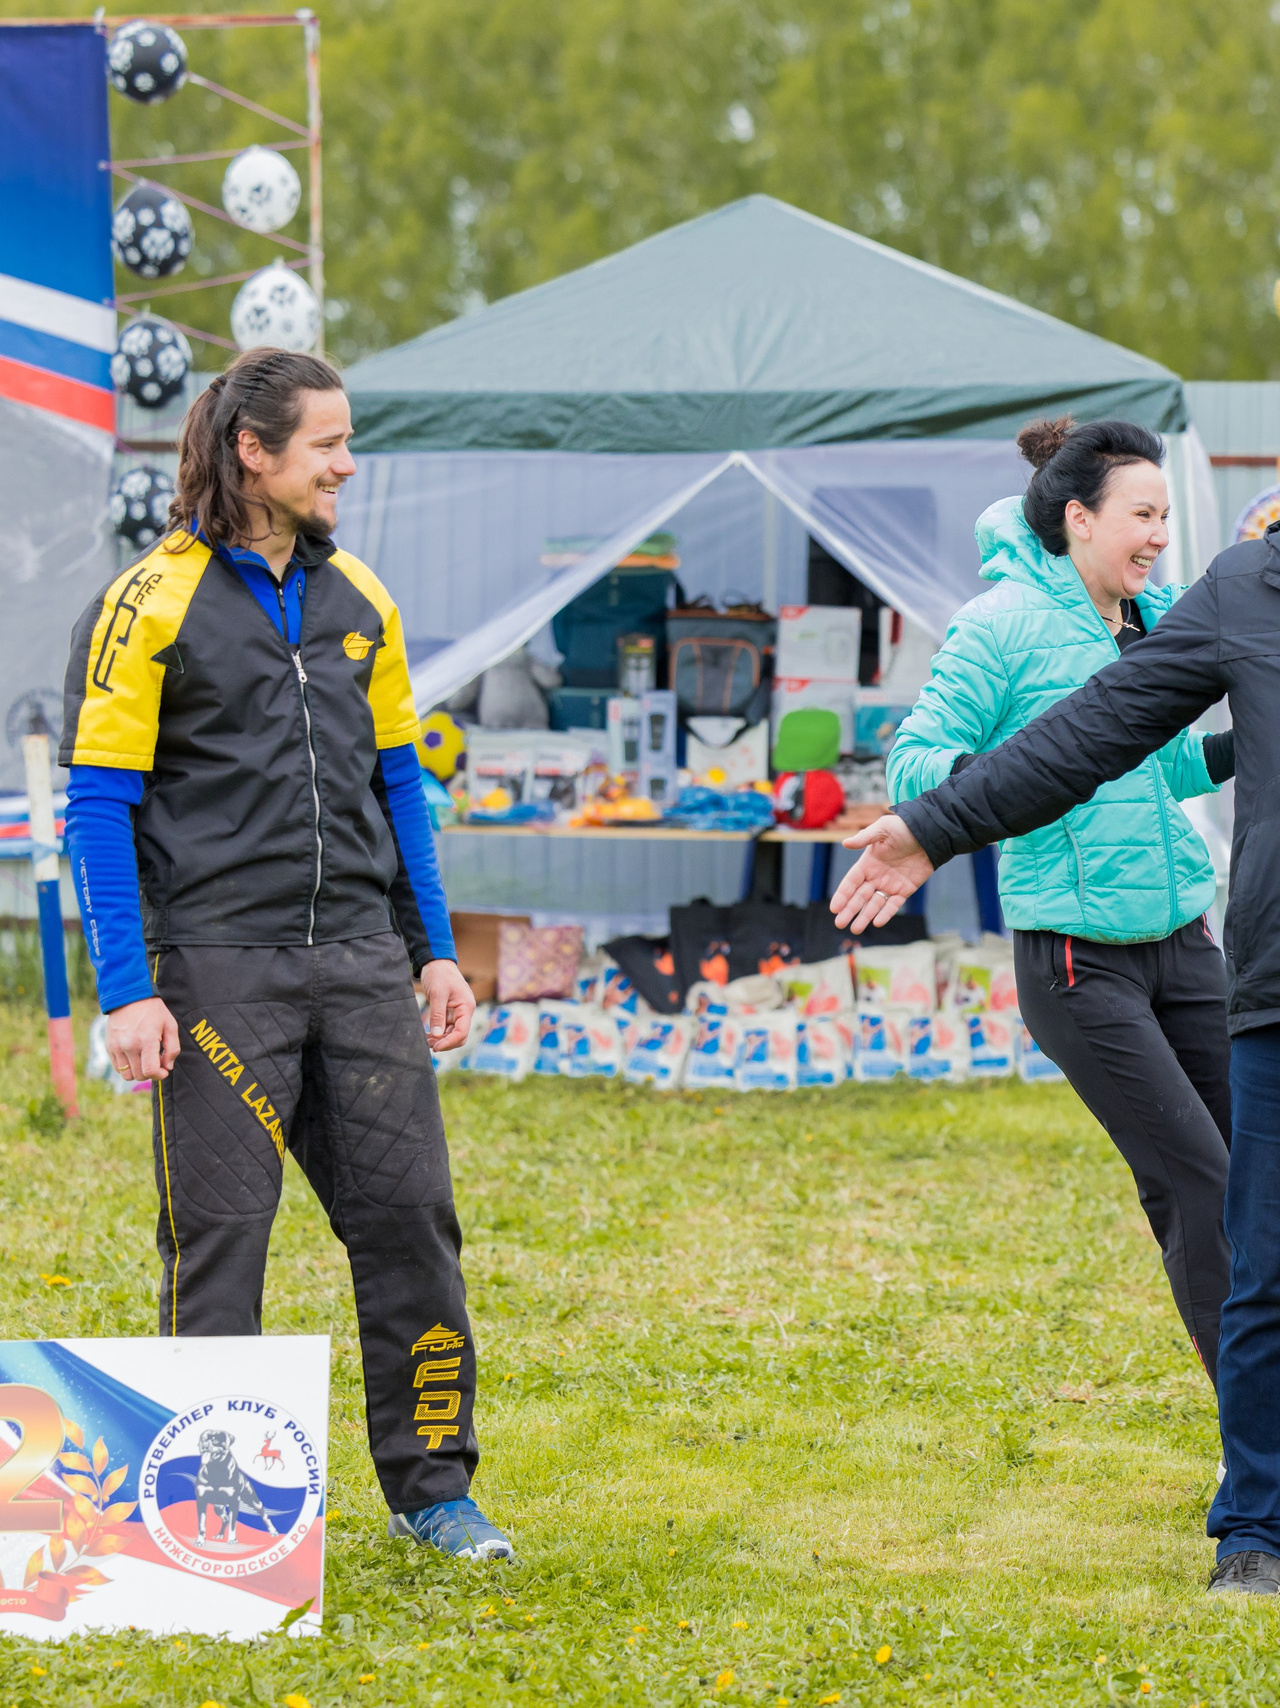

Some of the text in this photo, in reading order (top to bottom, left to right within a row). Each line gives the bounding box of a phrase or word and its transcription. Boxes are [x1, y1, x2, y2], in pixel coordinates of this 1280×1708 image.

[80, 857, 93, 913] VICTORY
[190, 1018, 245, 1086] NIKITA
[0, 1383, 66, 1533] 2
[144, 1400, 320, 1499] РОТВЕЙЛЕР КЛУБ РОССИИ
[154, 1523, 308, 1577] НИЖЕГОРОДСКОЕ РО
[0, 1598, 27, 1606] есто
